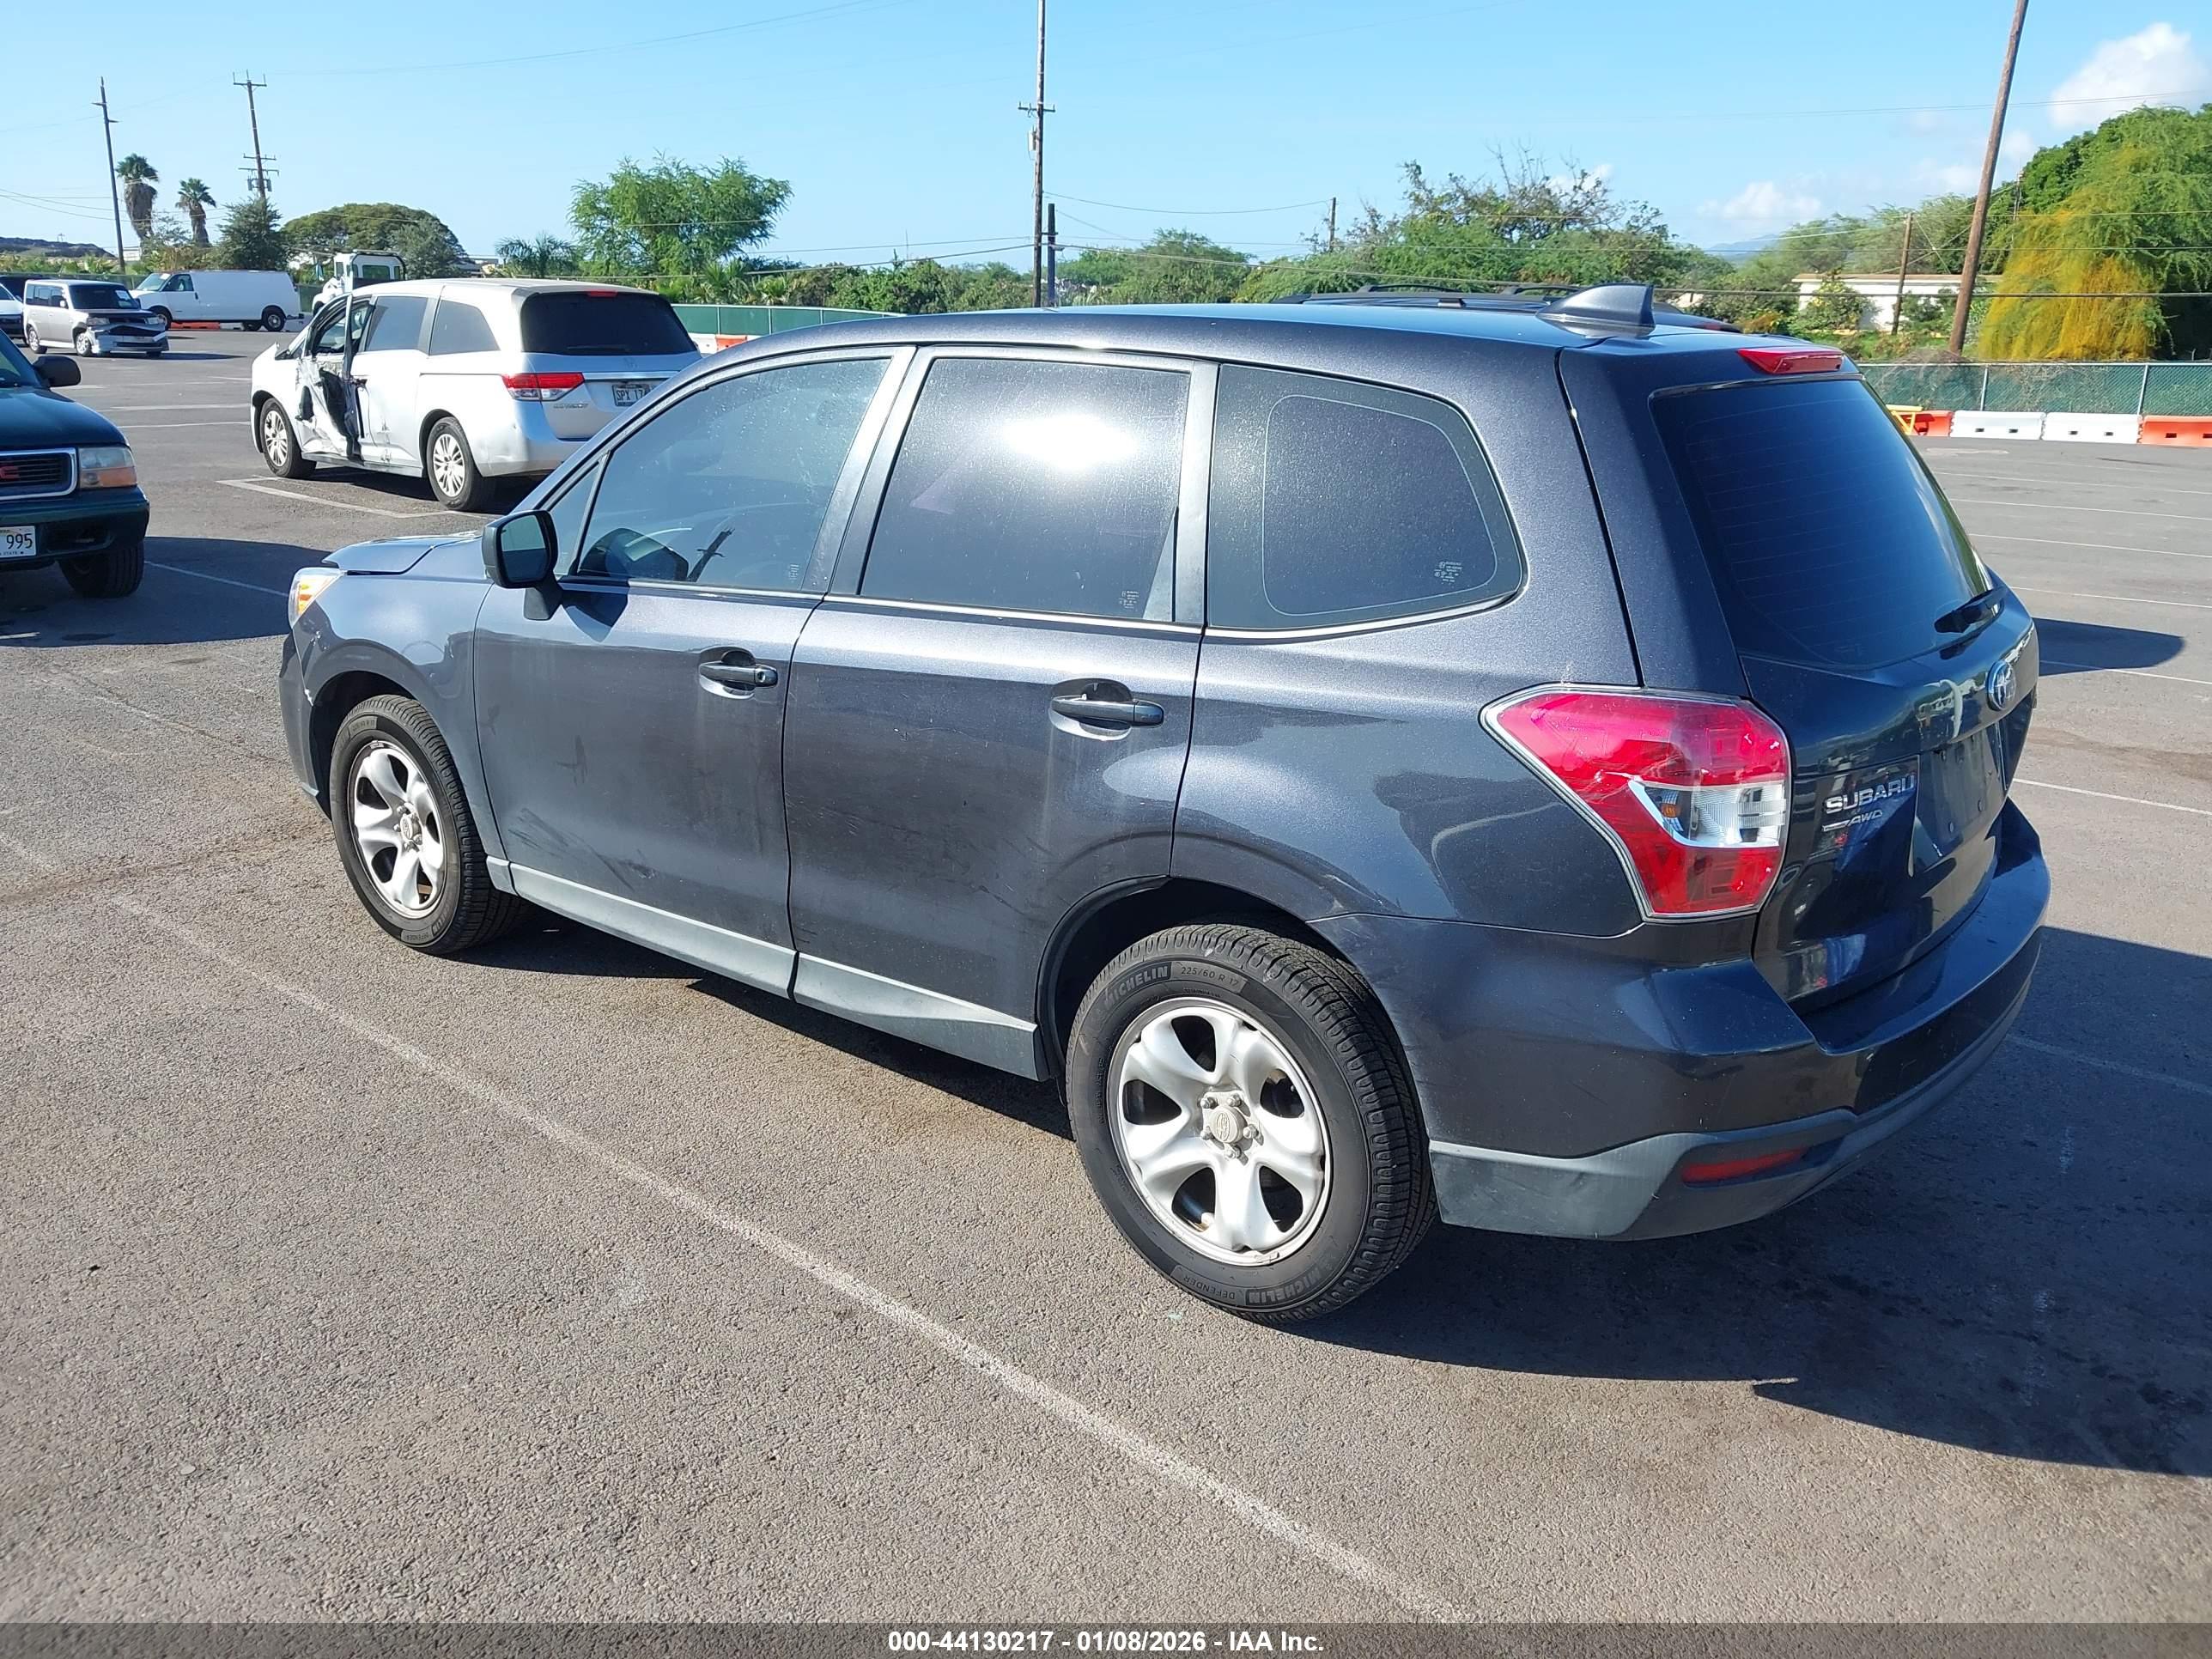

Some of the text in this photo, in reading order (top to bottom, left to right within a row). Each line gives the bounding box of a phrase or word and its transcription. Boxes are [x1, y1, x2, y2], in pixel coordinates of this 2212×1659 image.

[6, 533, 33, 550] 995
[1826, 775, 1915, 814] SUBARU
[1847, 809, 1883, 826] AWD
[1104, 966, 1169, 1008] MICHELIN
[1181, 967, 1239, 987] 225/60 R 17
[1183, 1274, 1236, 1300] DEFENDER
